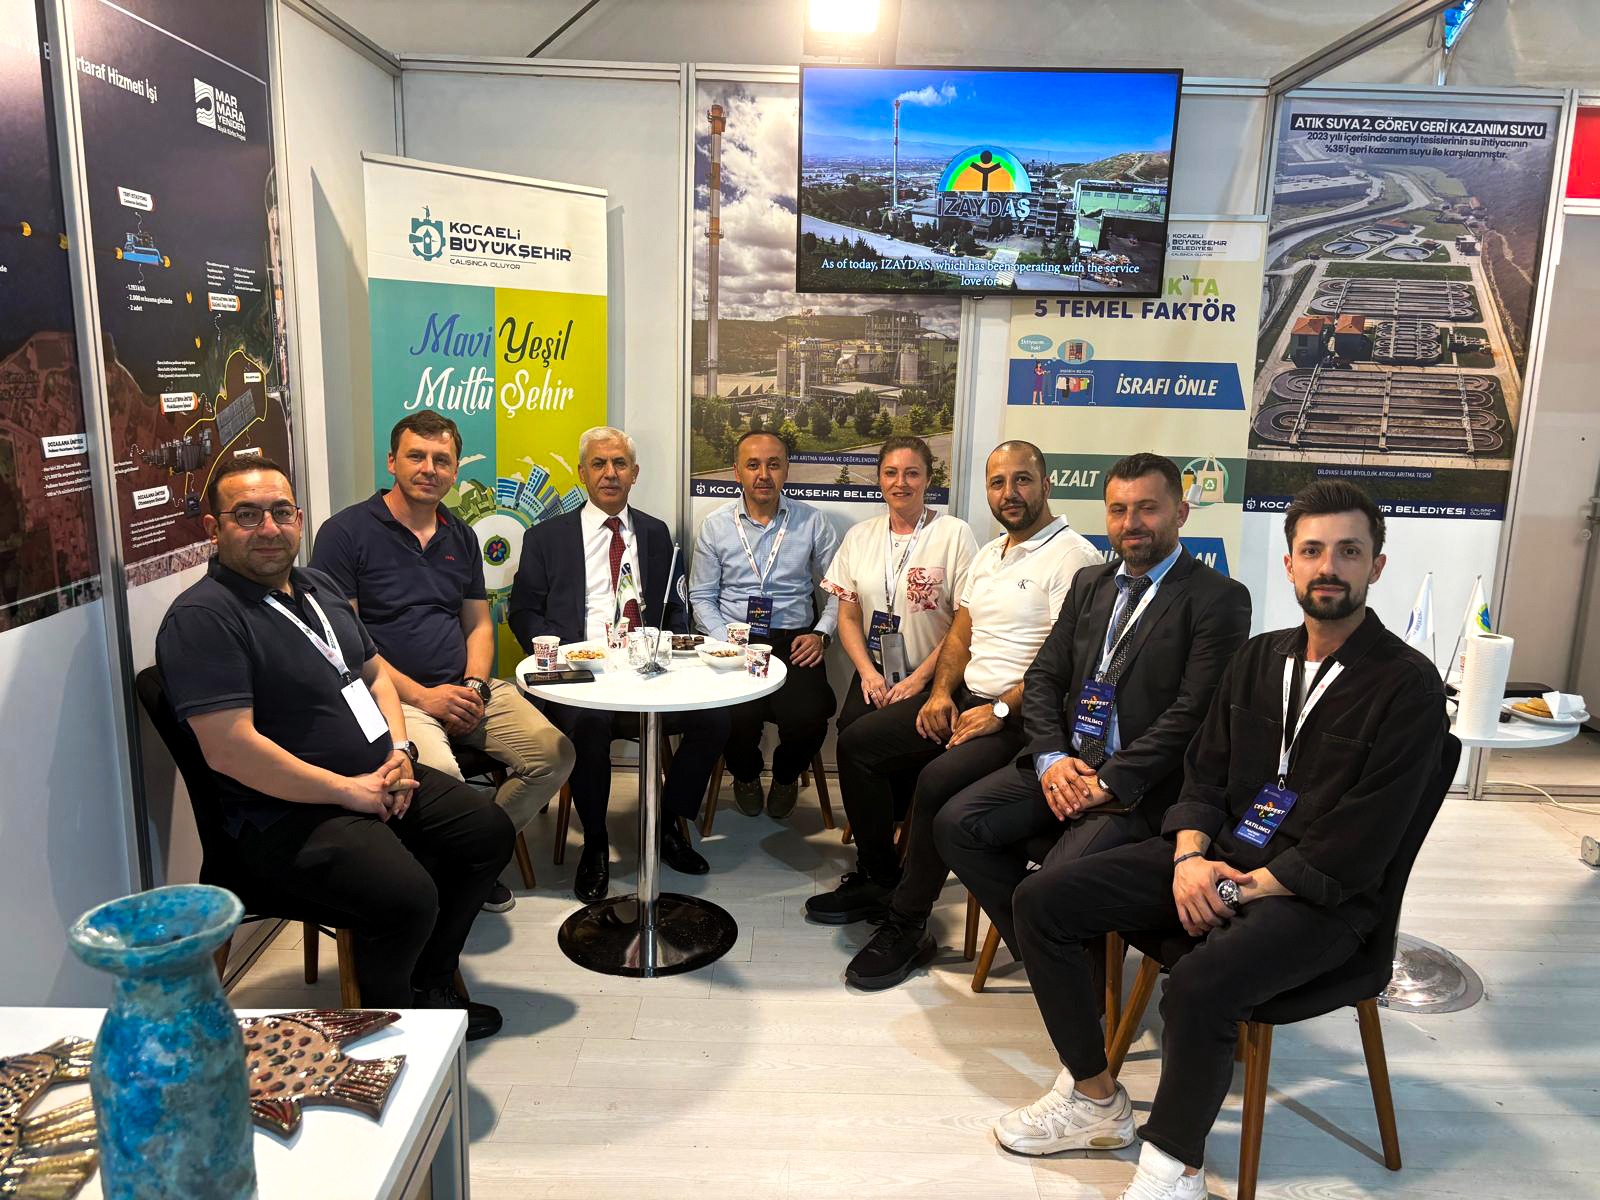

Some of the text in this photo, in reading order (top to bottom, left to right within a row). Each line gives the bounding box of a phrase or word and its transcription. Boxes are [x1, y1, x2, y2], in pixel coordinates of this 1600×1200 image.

[107, 66, 144, 96] Hizmeti
[145, 78, 157, 104] İşi
[215, 87, 238, 109] MAR
[216, 100, 246, 125] MARA
[1294, 116, 1544, 137] ATIK SUYA 2. GÖREV GERİ KAZANIM SUYU
[1307, 131, 1329, 141] 2023
[1343, 132, 1387, 144] içerisinde
[1387, 135, 1419, 146] sanayi
[1419, 136, 1468, 146] tesislerinin
[1468, 138, 1480, 146] su
[1349, 145, 1368, 156] geri
[1368, 145, 1408, 155] kazanım
[1408, 148, 1431, 158] suyu
[1432, 147, 1442, 156] ile
[489, 261, 521, 270] OLUYOR
[821, 258, 1141, 274] As of today, IZAYDAS, which has been operating with the service
[960, 275, 998, 286] love for
[1035, 298, 1236, 322] 5 TEMEL FAKTÖR
[410, 312, 574, 368] Mavi Yeşil
[403, 366, 575, 419] Mutlu Şehir
[1174, 374, 1219, 397] ÖNLE
[1050, 470, 1101, 488] AZALT
[709, 485, 884, 499] KOCA YÜKŞEHiR BELED
[1259, 500, 1292, 510] KOCA
[1244, 819, 1271, 834] KATILIMCI
